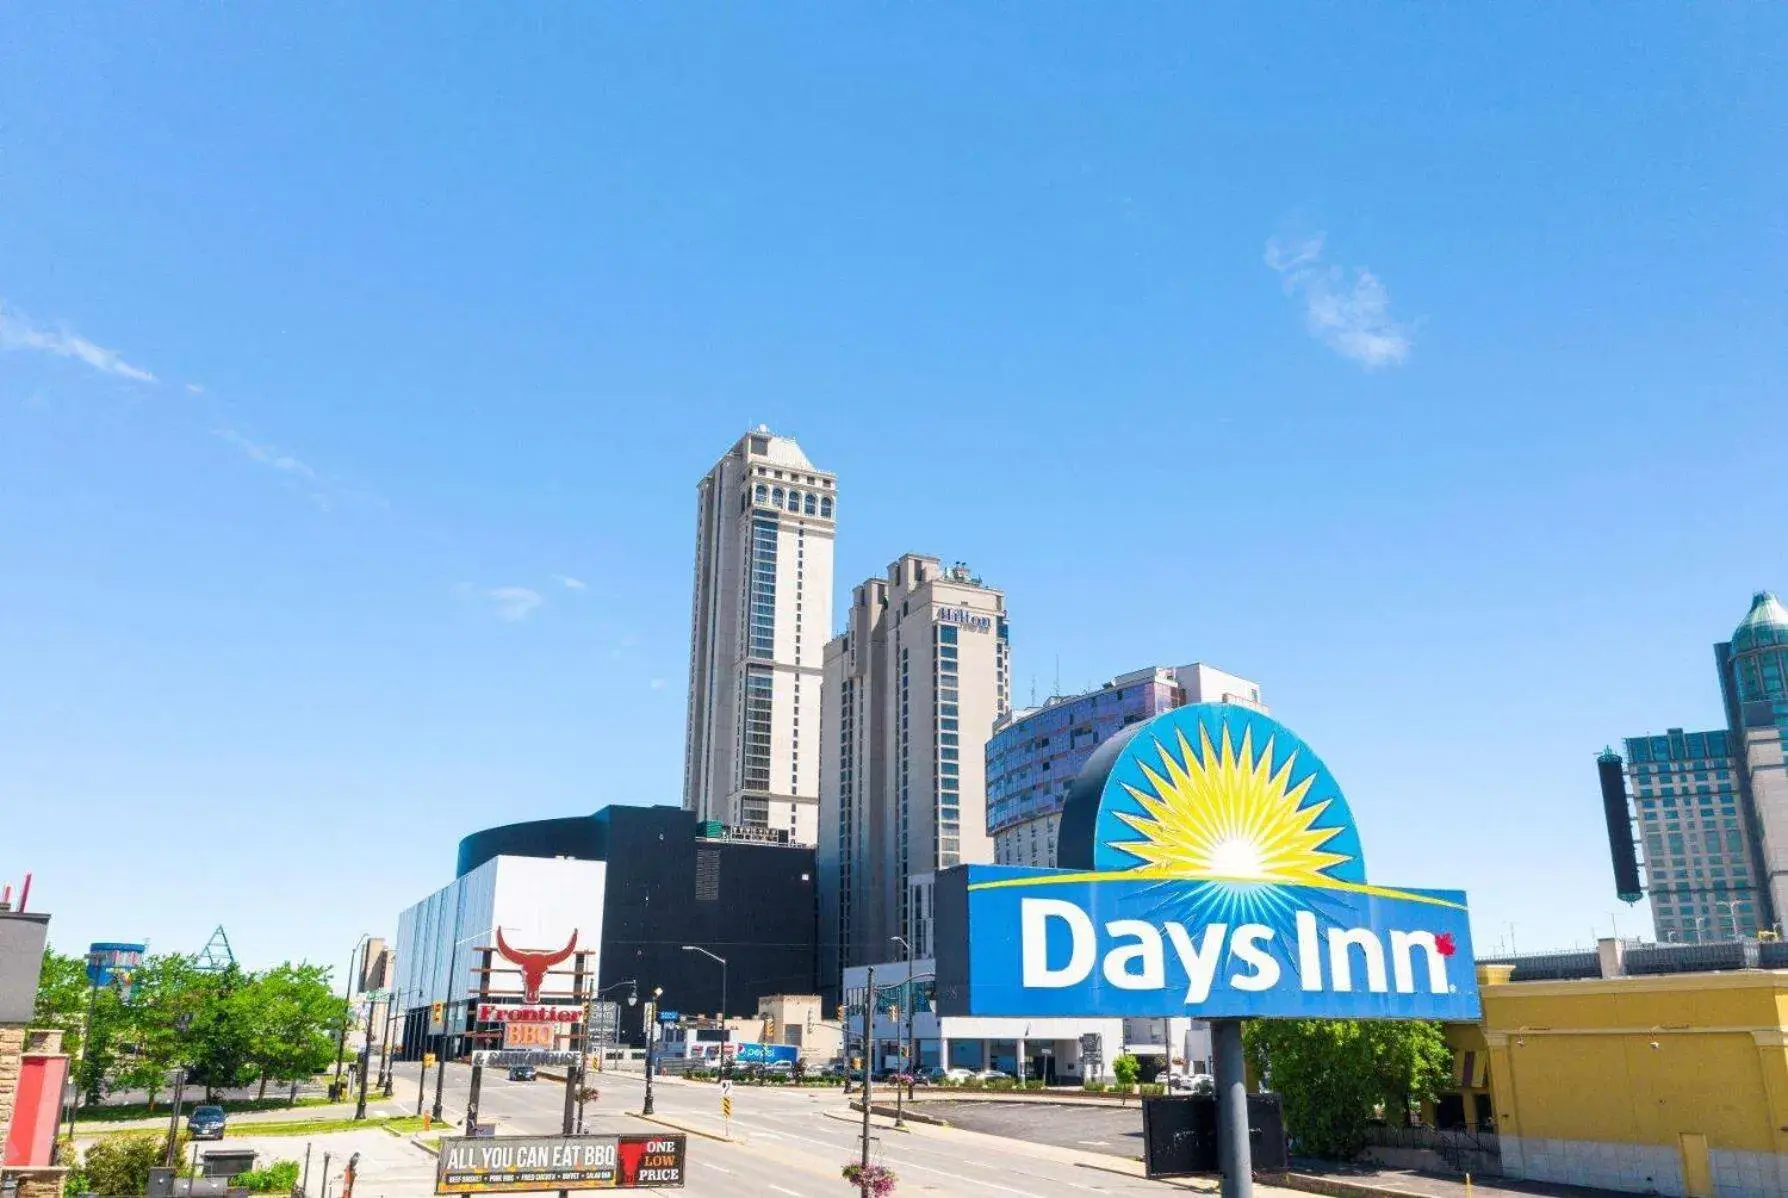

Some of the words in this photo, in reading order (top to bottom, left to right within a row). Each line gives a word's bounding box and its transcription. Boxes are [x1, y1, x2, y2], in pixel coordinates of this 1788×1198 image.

[938, 607, 991, 629] Hilton
[1021, 897, 1281, 1004] Days
[1296, 910, 1449, 993] Inn
[480, 1005, 583, 1022] Frontier
[508, 1024, 551, 1046] BBQ
[646, 1141, 675, 1152] ONE
[447, 1149, 478, 1169] ALL
[483, 1147, 512, 1169] YOU
[516, 1146, 549, 1168] CAN
[552, 1145, 581, 1167] EAT
[584, 1145, 615, 1167] BBQ
[644, 1155, 675, 1167] LOW
[638, 1168, 679, 1180] PRICE
